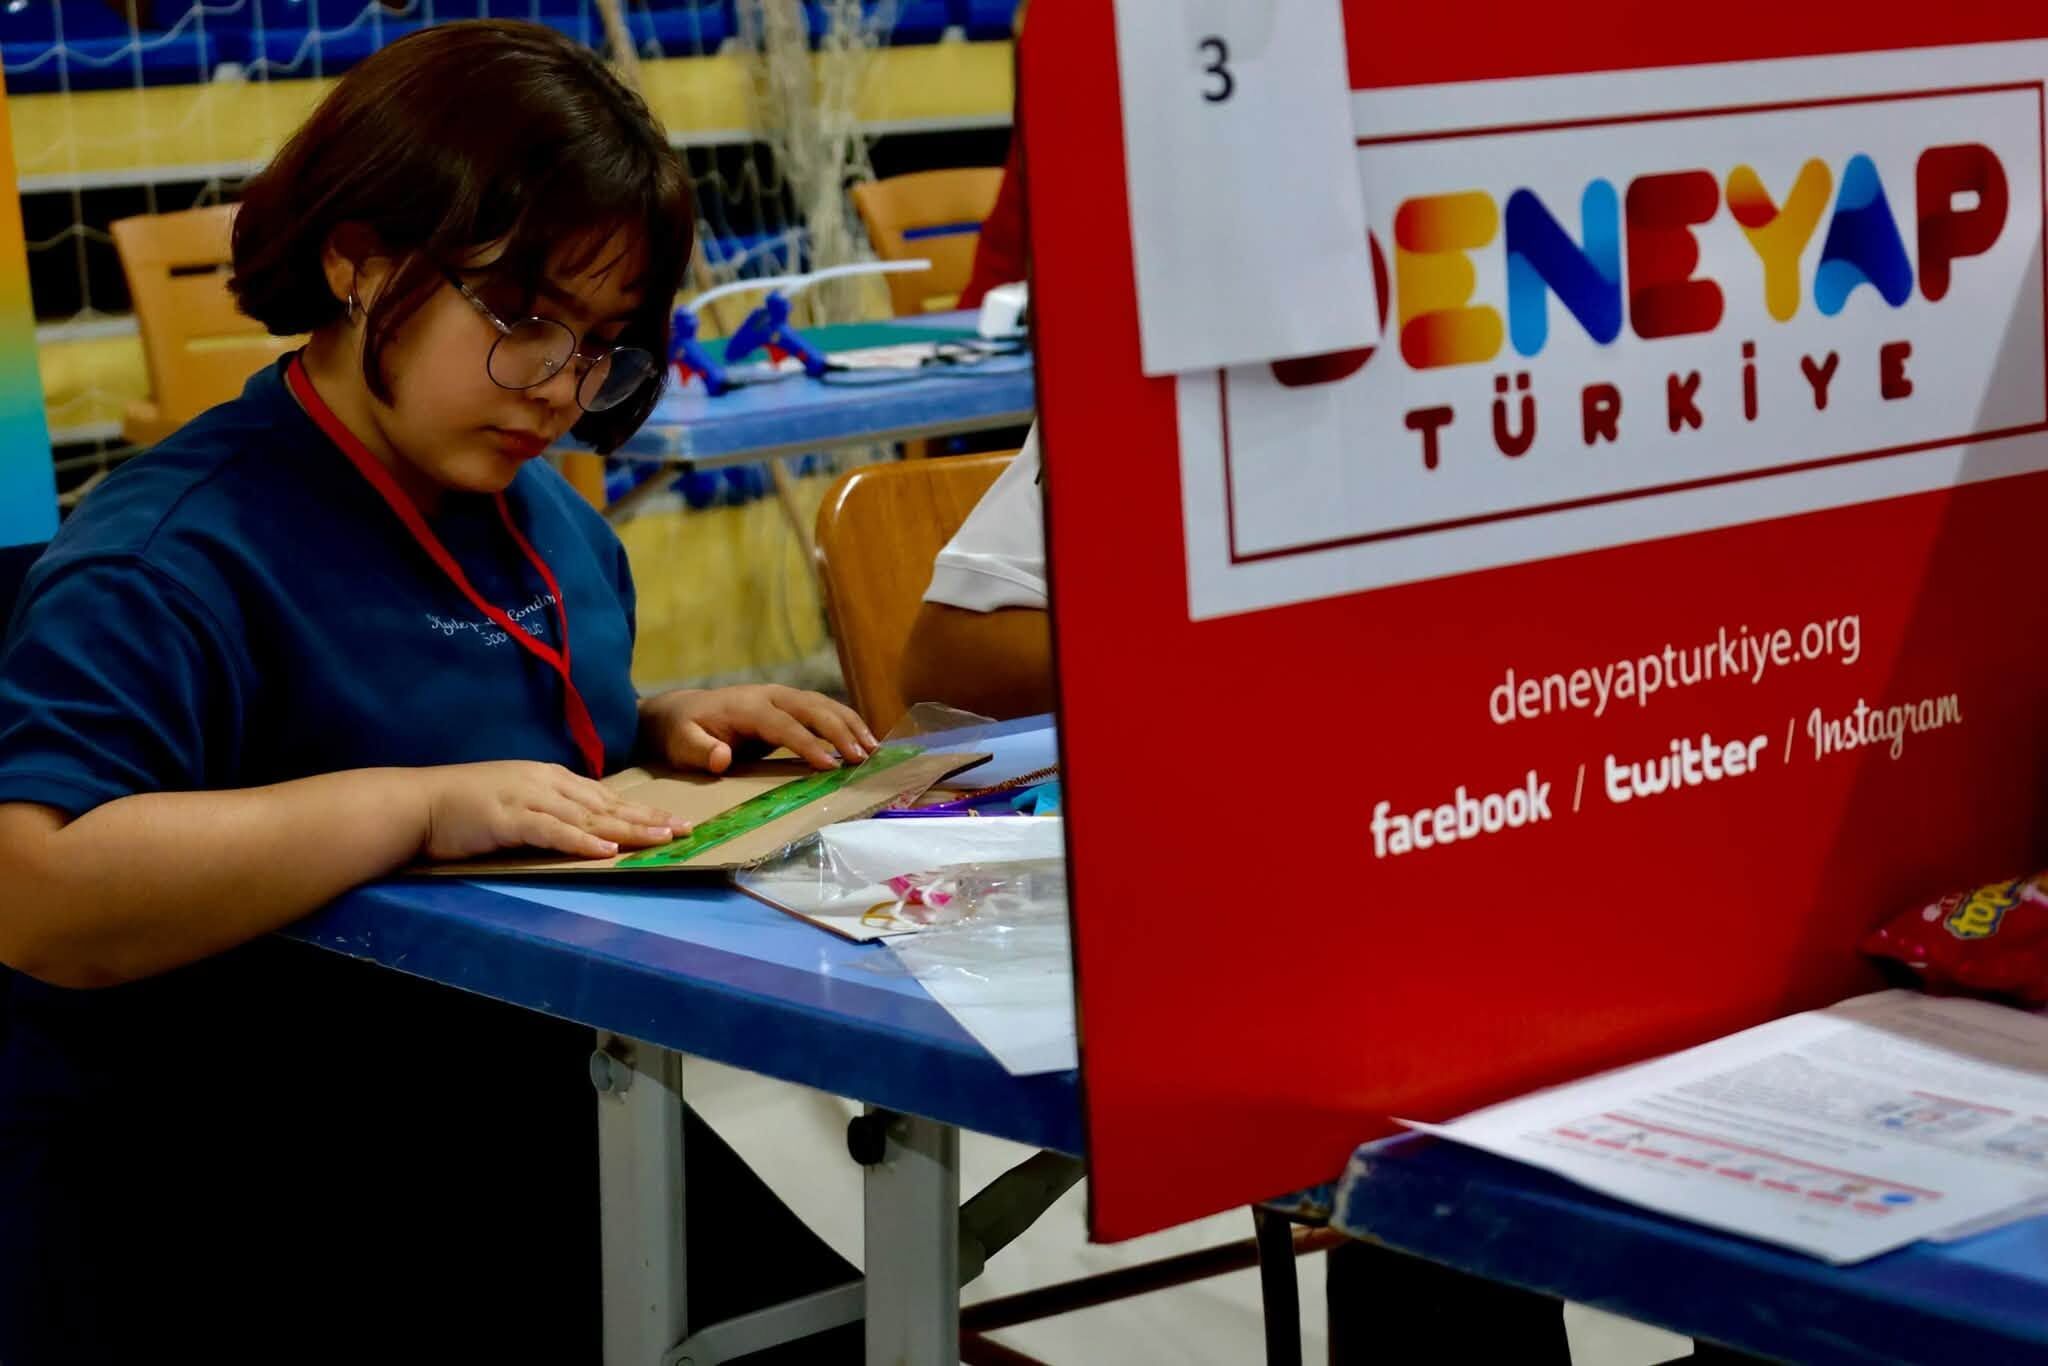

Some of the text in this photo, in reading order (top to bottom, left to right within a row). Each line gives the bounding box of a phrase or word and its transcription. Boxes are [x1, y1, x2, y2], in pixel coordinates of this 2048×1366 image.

[1200, 37, 1235, 103] 3
[1267, 142, 2010, 388] ENEYAP
[1405, 340, 1914, 471] TÜRKİYE
[1488, 614, 1861, 725] deneyapturkiye.org
[1369, 769, 1553, 859] facebook
[1604, 732, 1769, 804] twitter
[1806, 693, 1963, 761] Instagram
